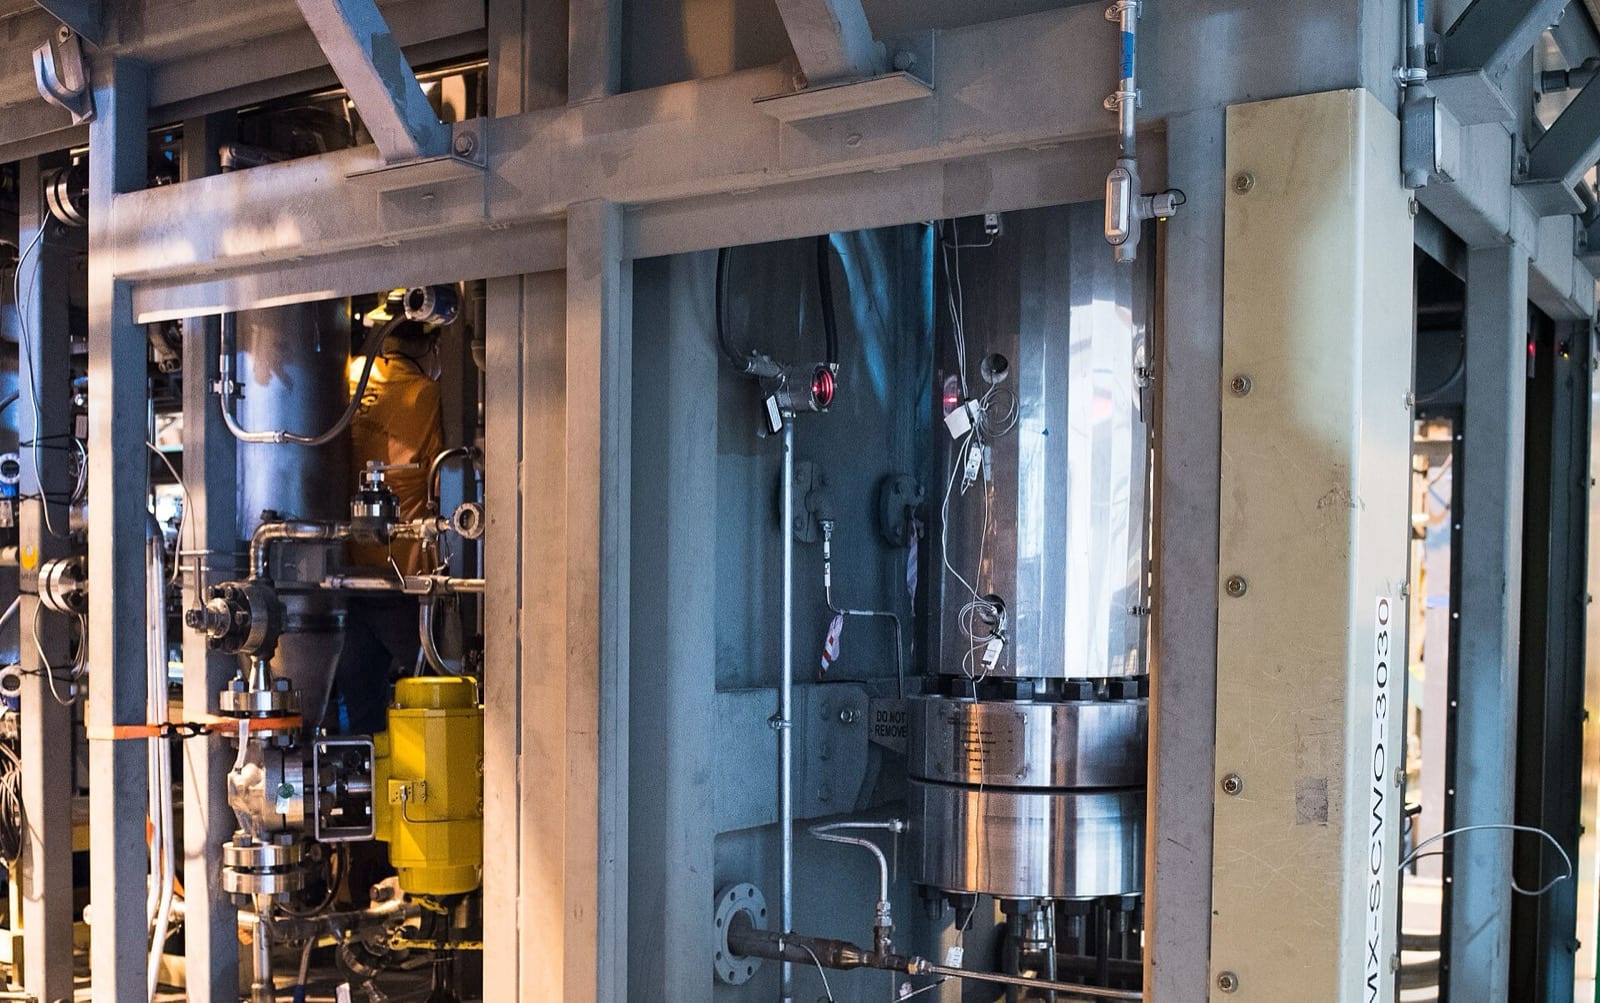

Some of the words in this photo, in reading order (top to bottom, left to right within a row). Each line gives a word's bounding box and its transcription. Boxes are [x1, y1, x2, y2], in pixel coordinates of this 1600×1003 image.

[876, 710, 888, 722] DO
[889, 711, 906, 724] NOT
[874, 724, 908, 738] REMOVE
